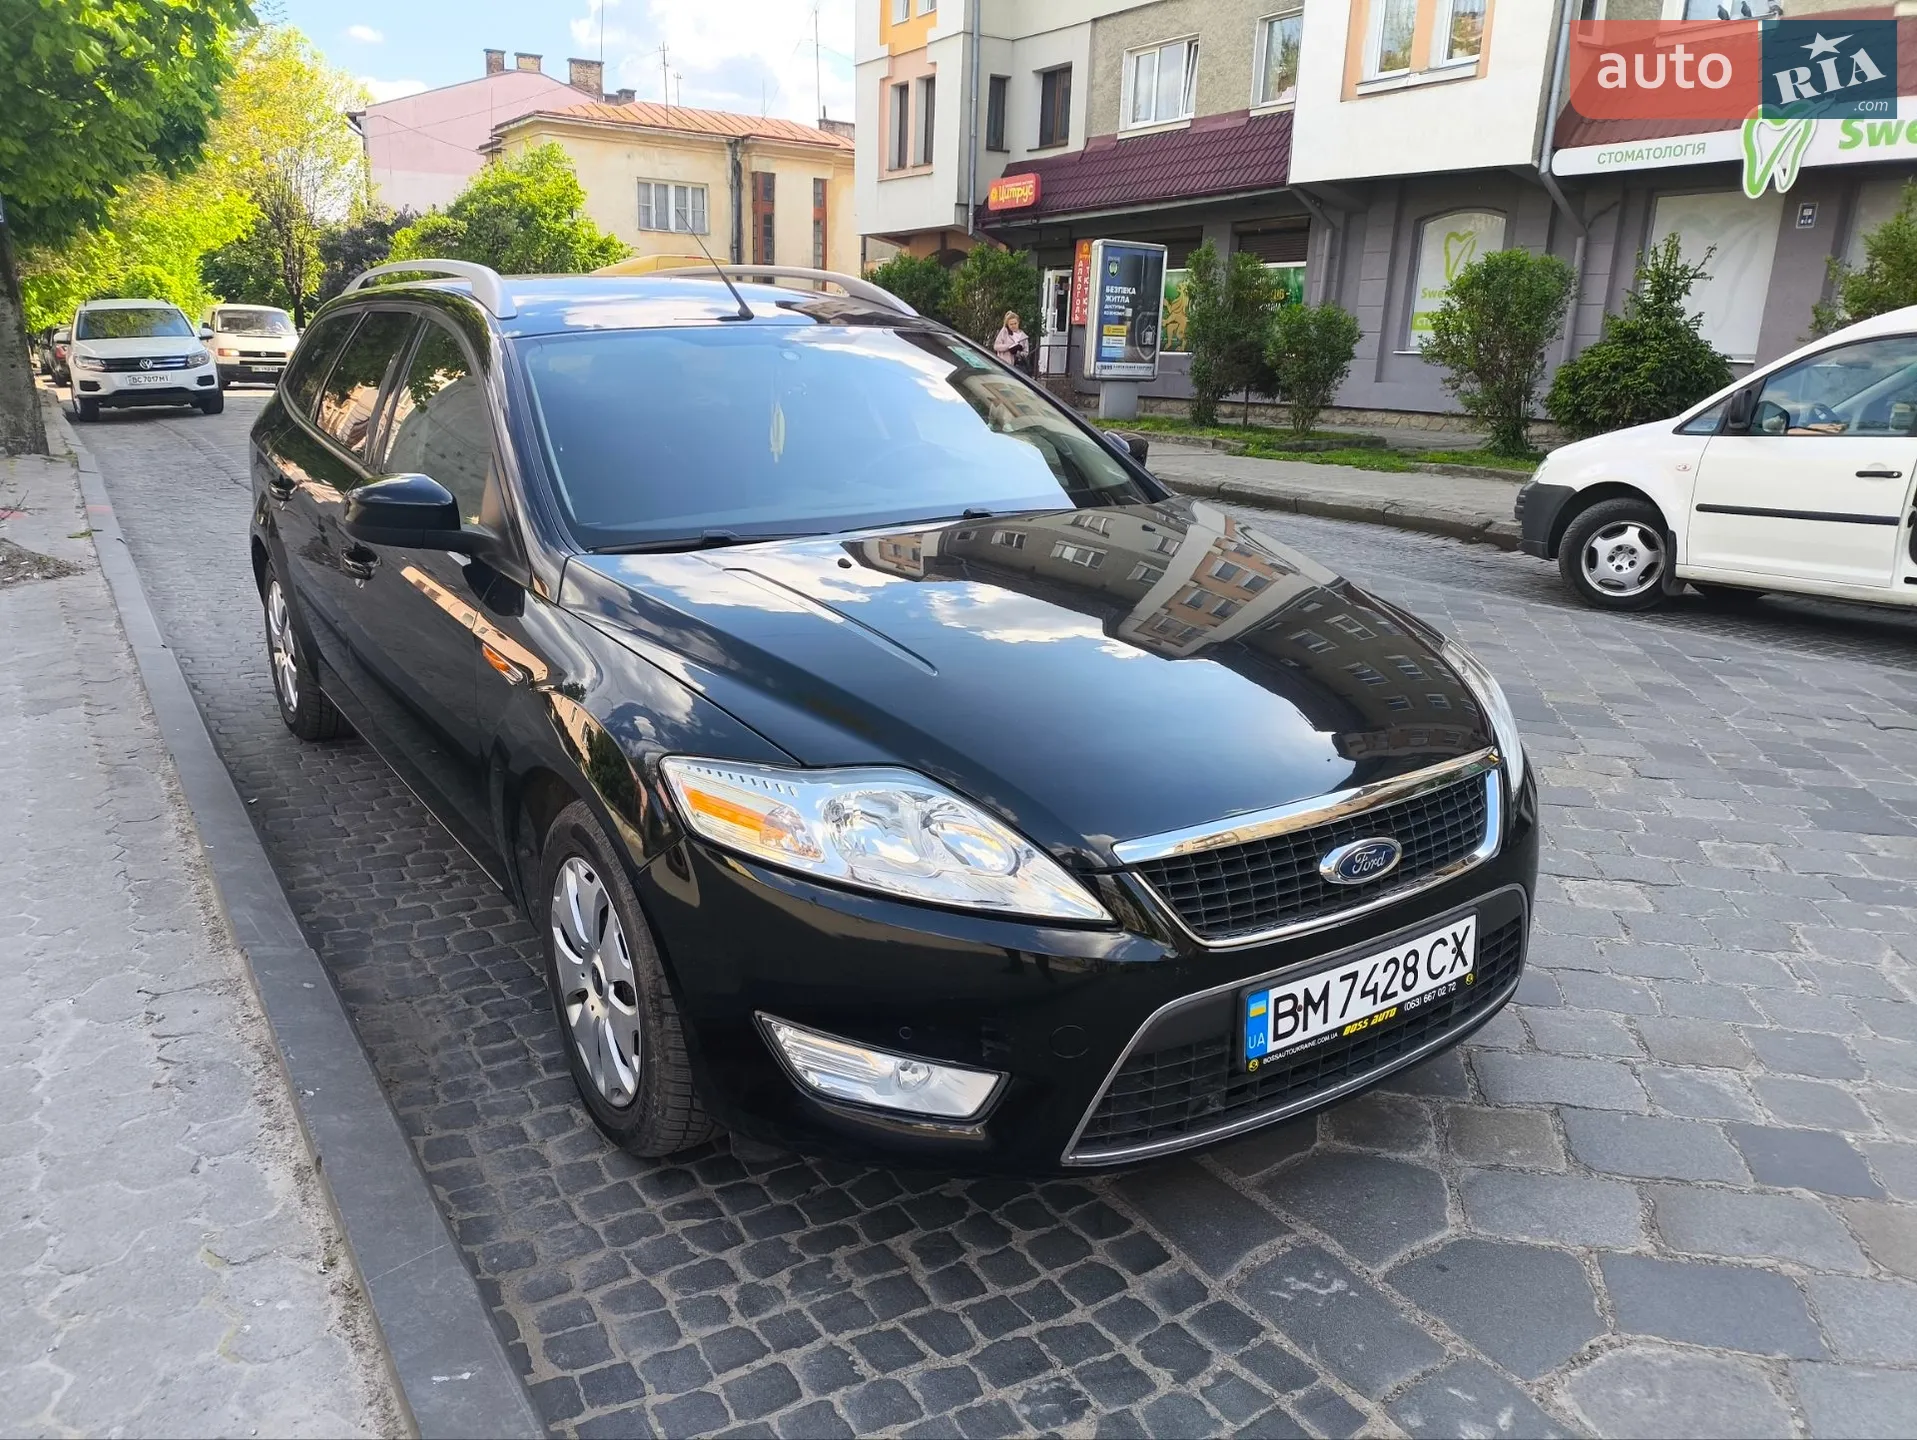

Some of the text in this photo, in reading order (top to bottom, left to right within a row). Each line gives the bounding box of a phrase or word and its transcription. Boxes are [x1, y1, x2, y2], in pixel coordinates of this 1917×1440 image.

[1597, 142, 1706, 165] СТОМАТОЛОГІЯ
[998, 184, 1034, 205] Цитрус
[1074, 259, 1084, 321] АЛКОГОЛЬ
[1104, 294, 1130, 304] ЖИТЛА
[1105, 285, 1137, 295] БЕЗПЕКА
[1351, 849, 1387, 875] Ford
[1272, 924, 1478, 1042] BM 7428 CX
[1423, 990, 1437, 1003] 667
[1437, 986, 1447, 997] 02
[1447, 981, 1457, 994] 72
[1248, 1032, 1265, 1049] UA
